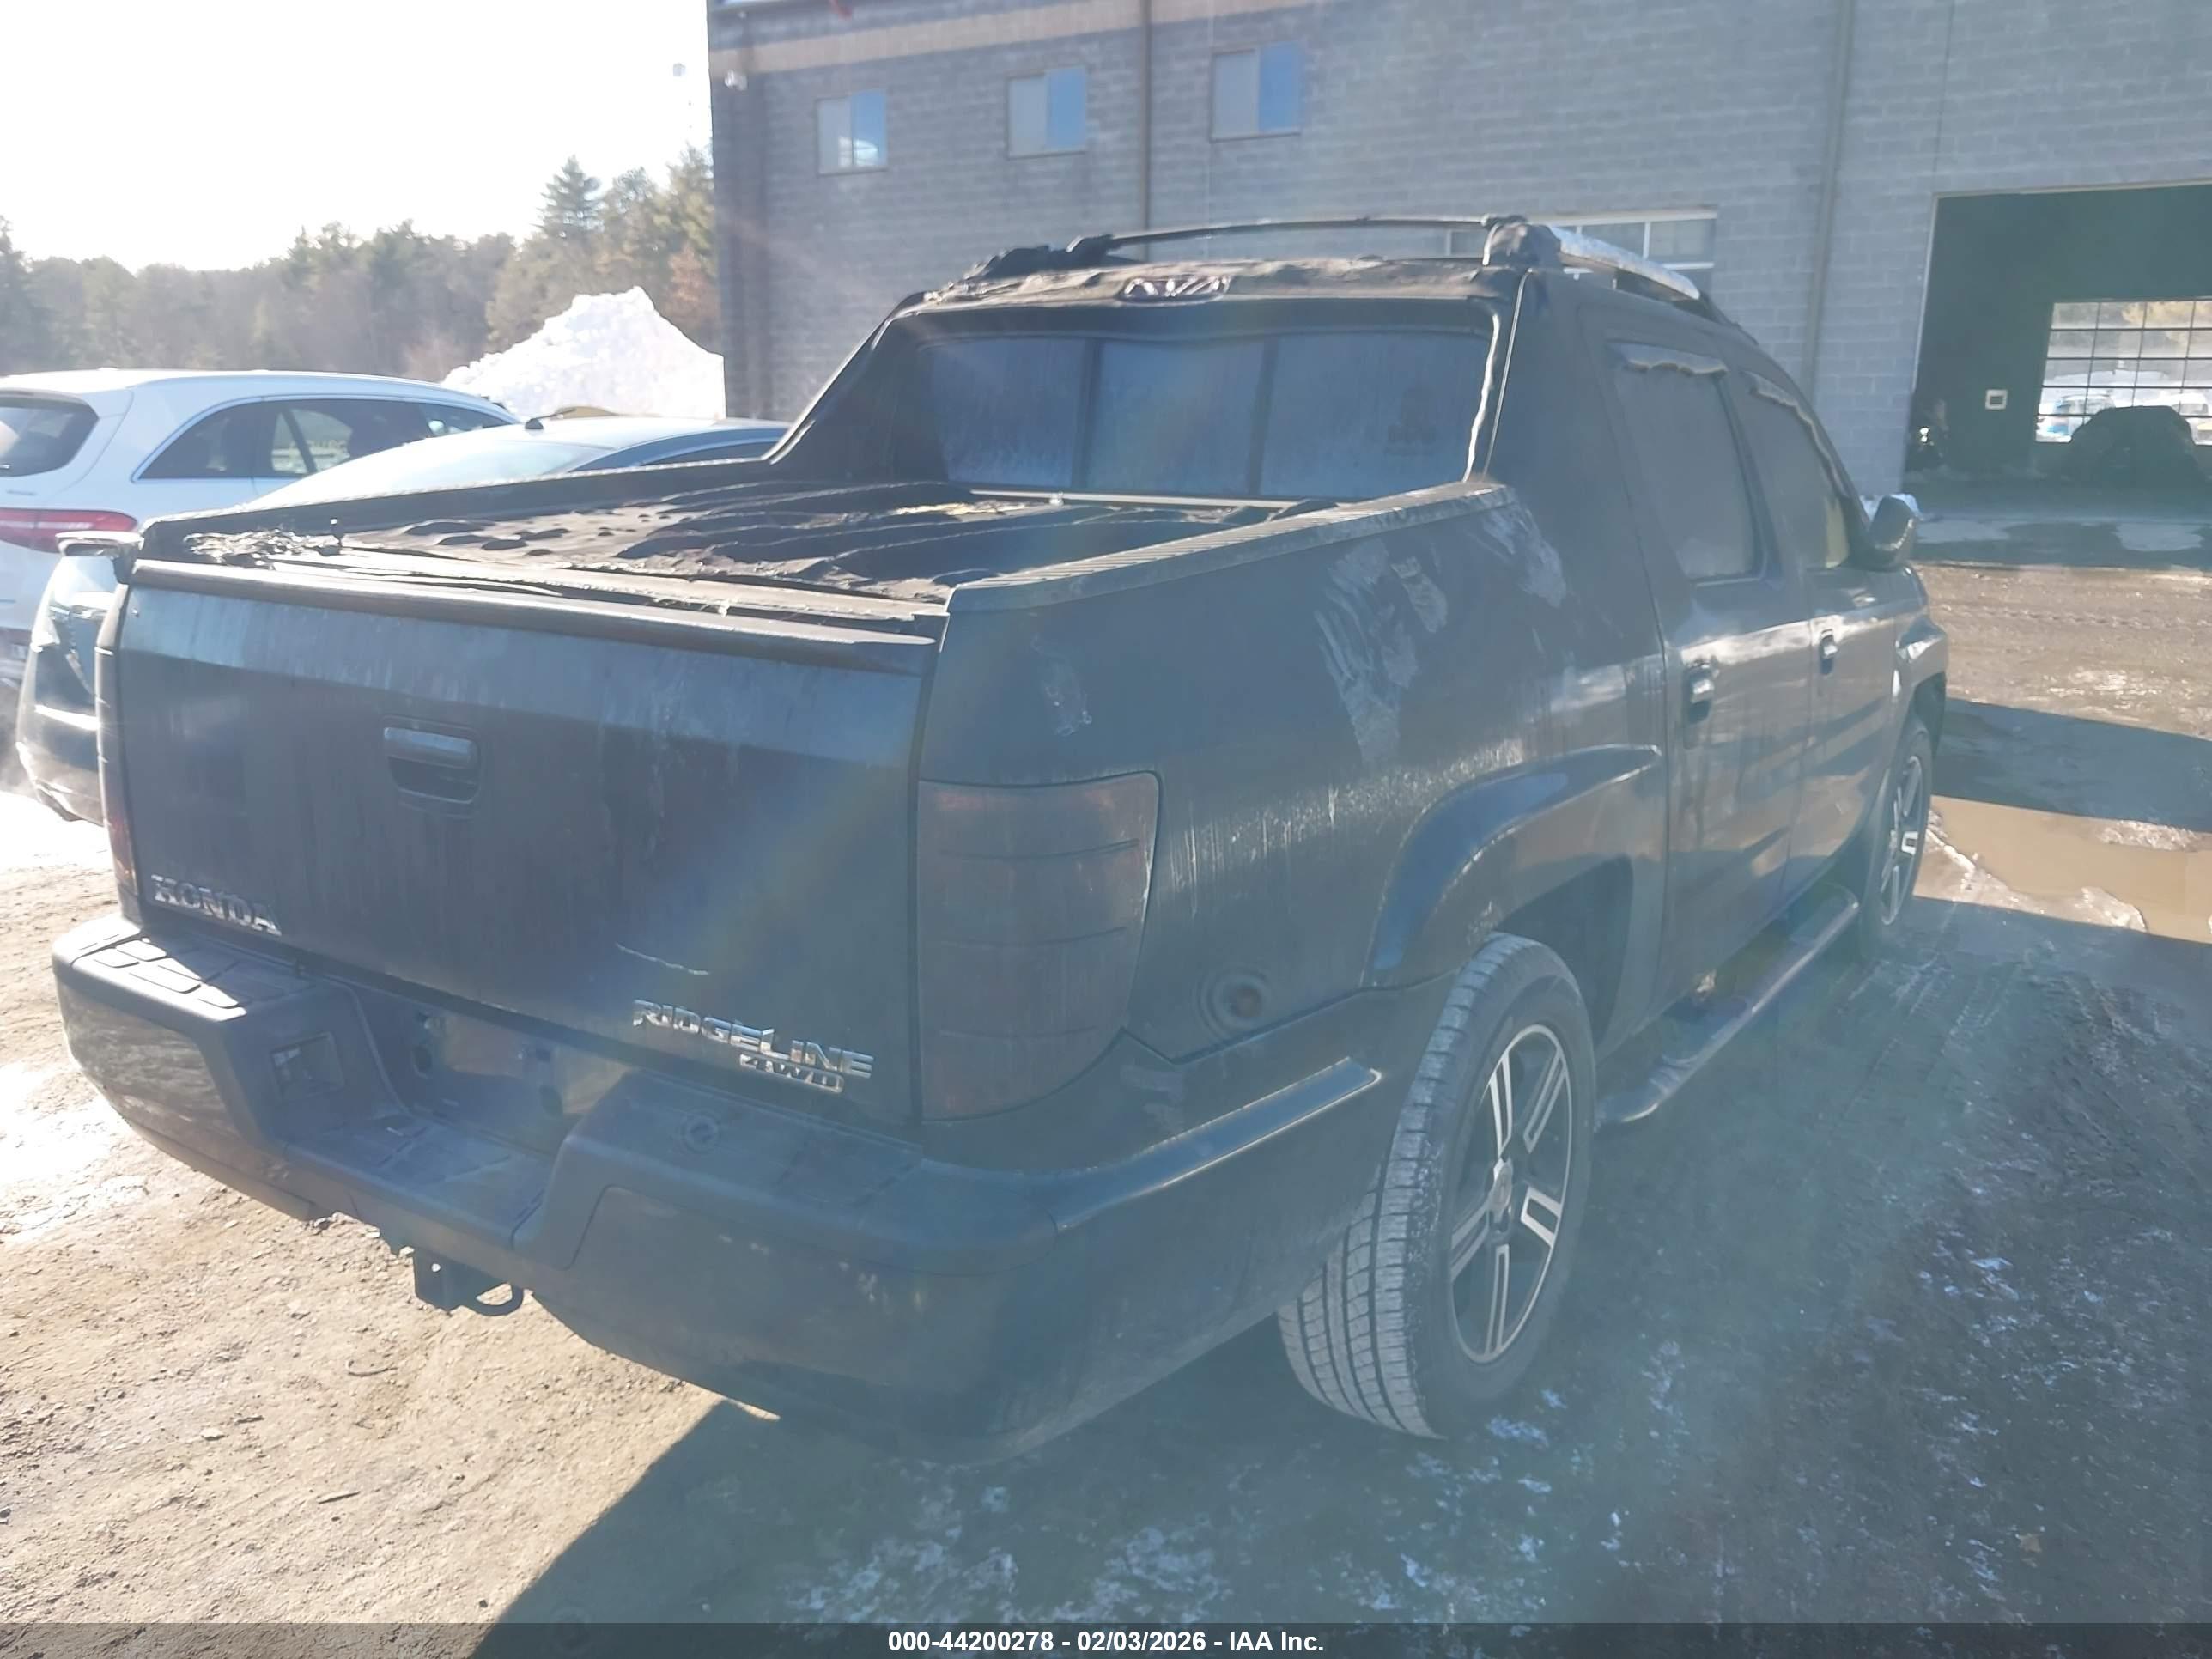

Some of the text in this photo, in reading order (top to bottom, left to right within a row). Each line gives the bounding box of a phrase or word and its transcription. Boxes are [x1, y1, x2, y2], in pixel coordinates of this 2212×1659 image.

[150, 873, 283, 937] HONDA
[632, 999, 874, 1079] RIDGELINE
[739, 1053, 845, 1093] 4WD
